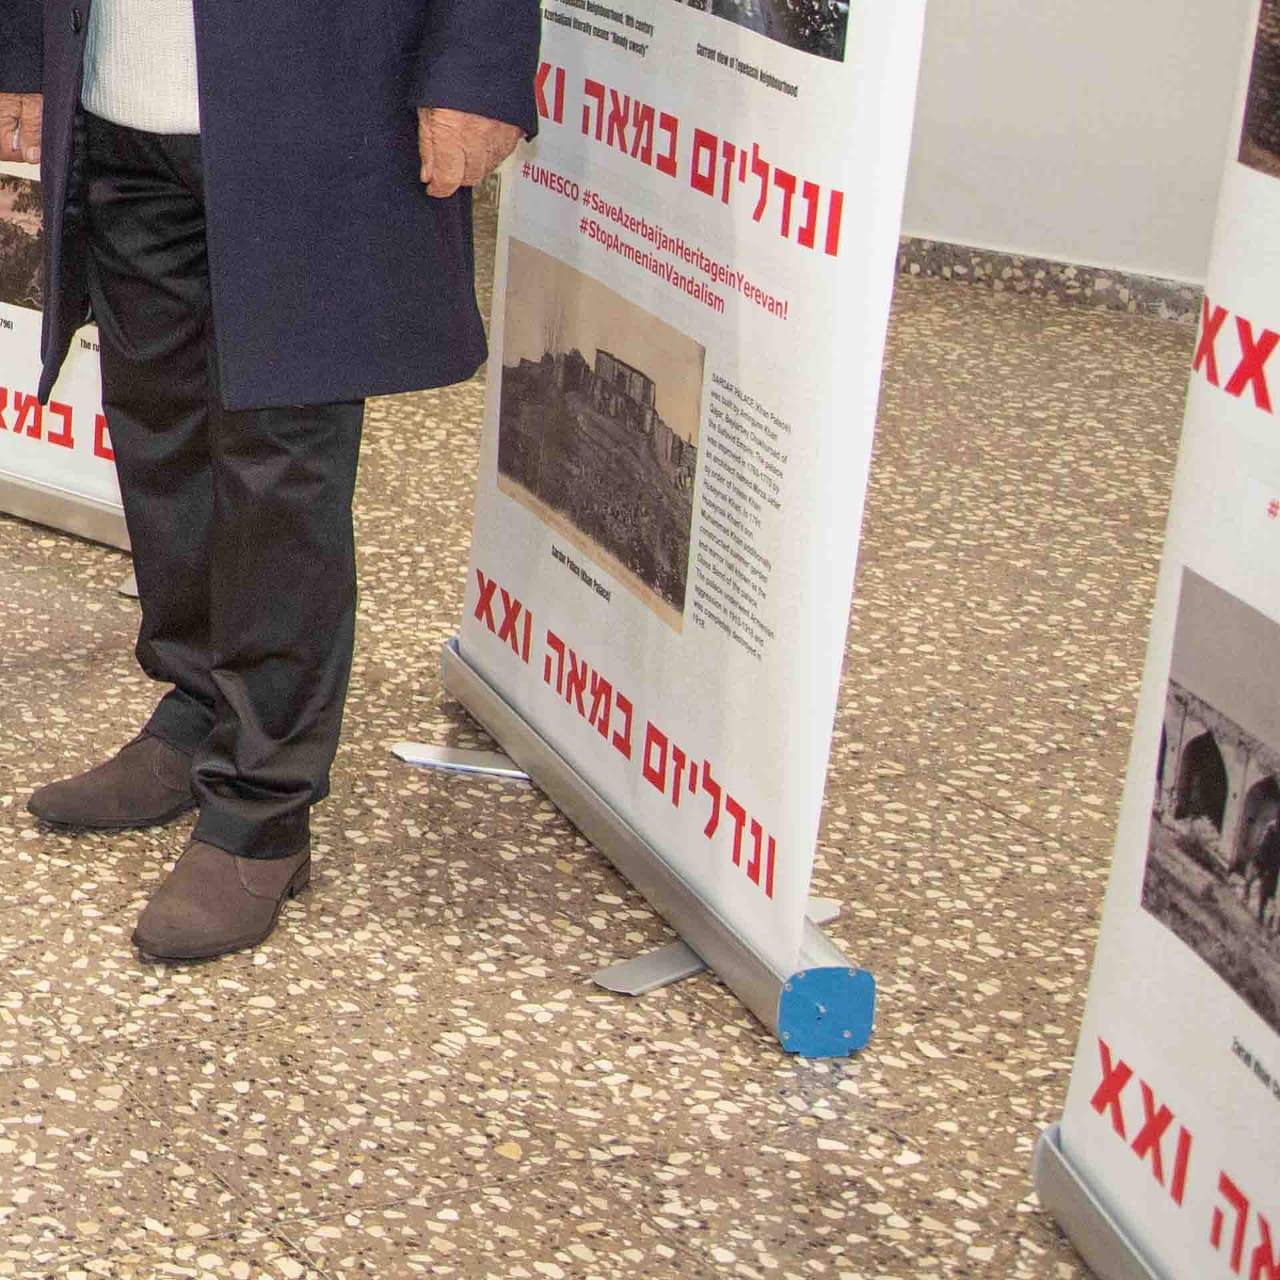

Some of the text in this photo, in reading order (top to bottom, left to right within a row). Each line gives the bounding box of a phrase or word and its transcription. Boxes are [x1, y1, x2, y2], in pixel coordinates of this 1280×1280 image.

[582, 78, 679, 178] במאה
[690, 127, 844, 257] ונדליזם
[522, 162, 789, 321] #UNESCO #SaveAzerbaijanHeritageinYerevan!
[579, 216, 725, 314] #StopArmenianVandalism
[474, 567, 776, 901] ונדליזם במאה XXI
[1090, 1036, 1193, 1208] XXI
